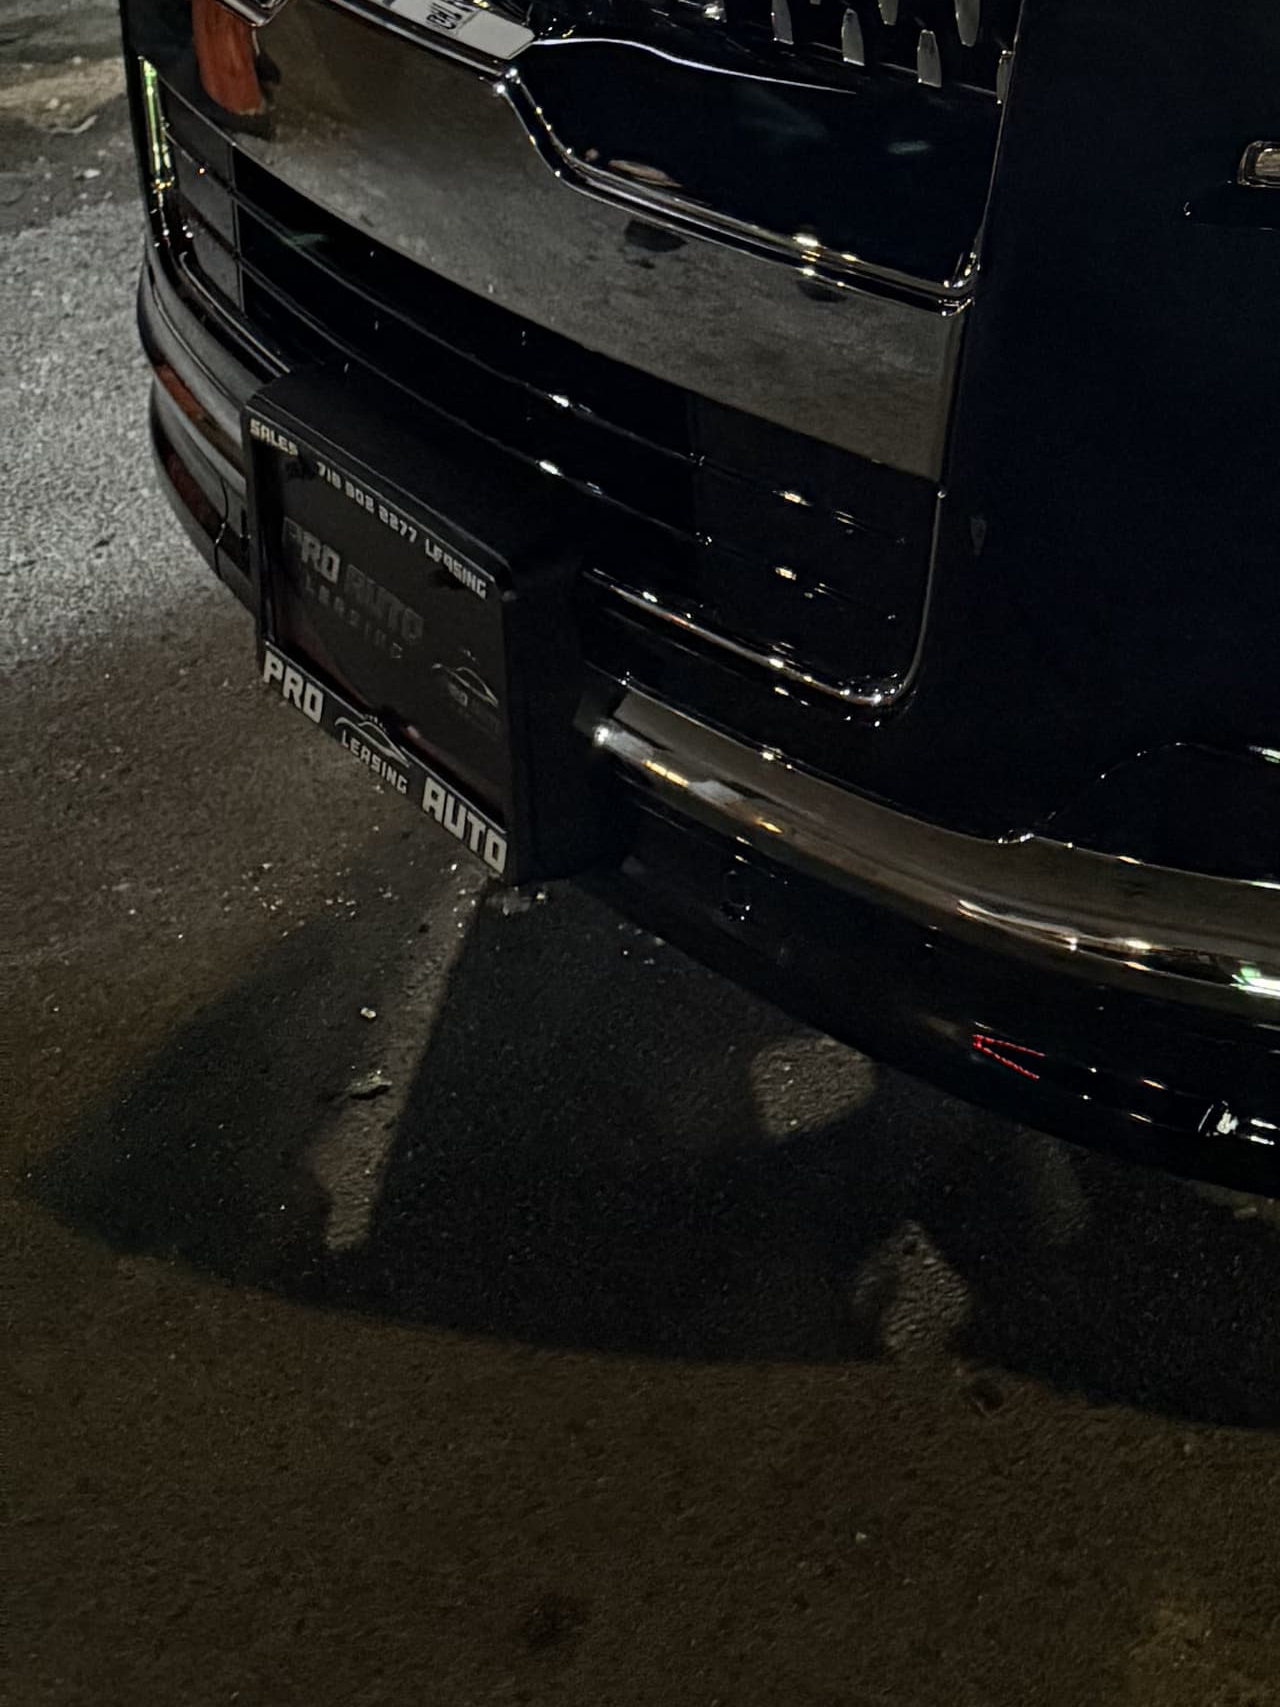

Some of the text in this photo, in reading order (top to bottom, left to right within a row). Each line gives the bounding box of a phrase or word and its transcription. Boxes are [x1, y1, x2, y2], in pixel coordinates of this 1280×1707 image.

[249, 417, 299, 457] SALES
[424, 538, 488, 601] LEASING
[263, 649, 508, 874] PRO AUTO
[340, 730, 409, 795] LEASING
